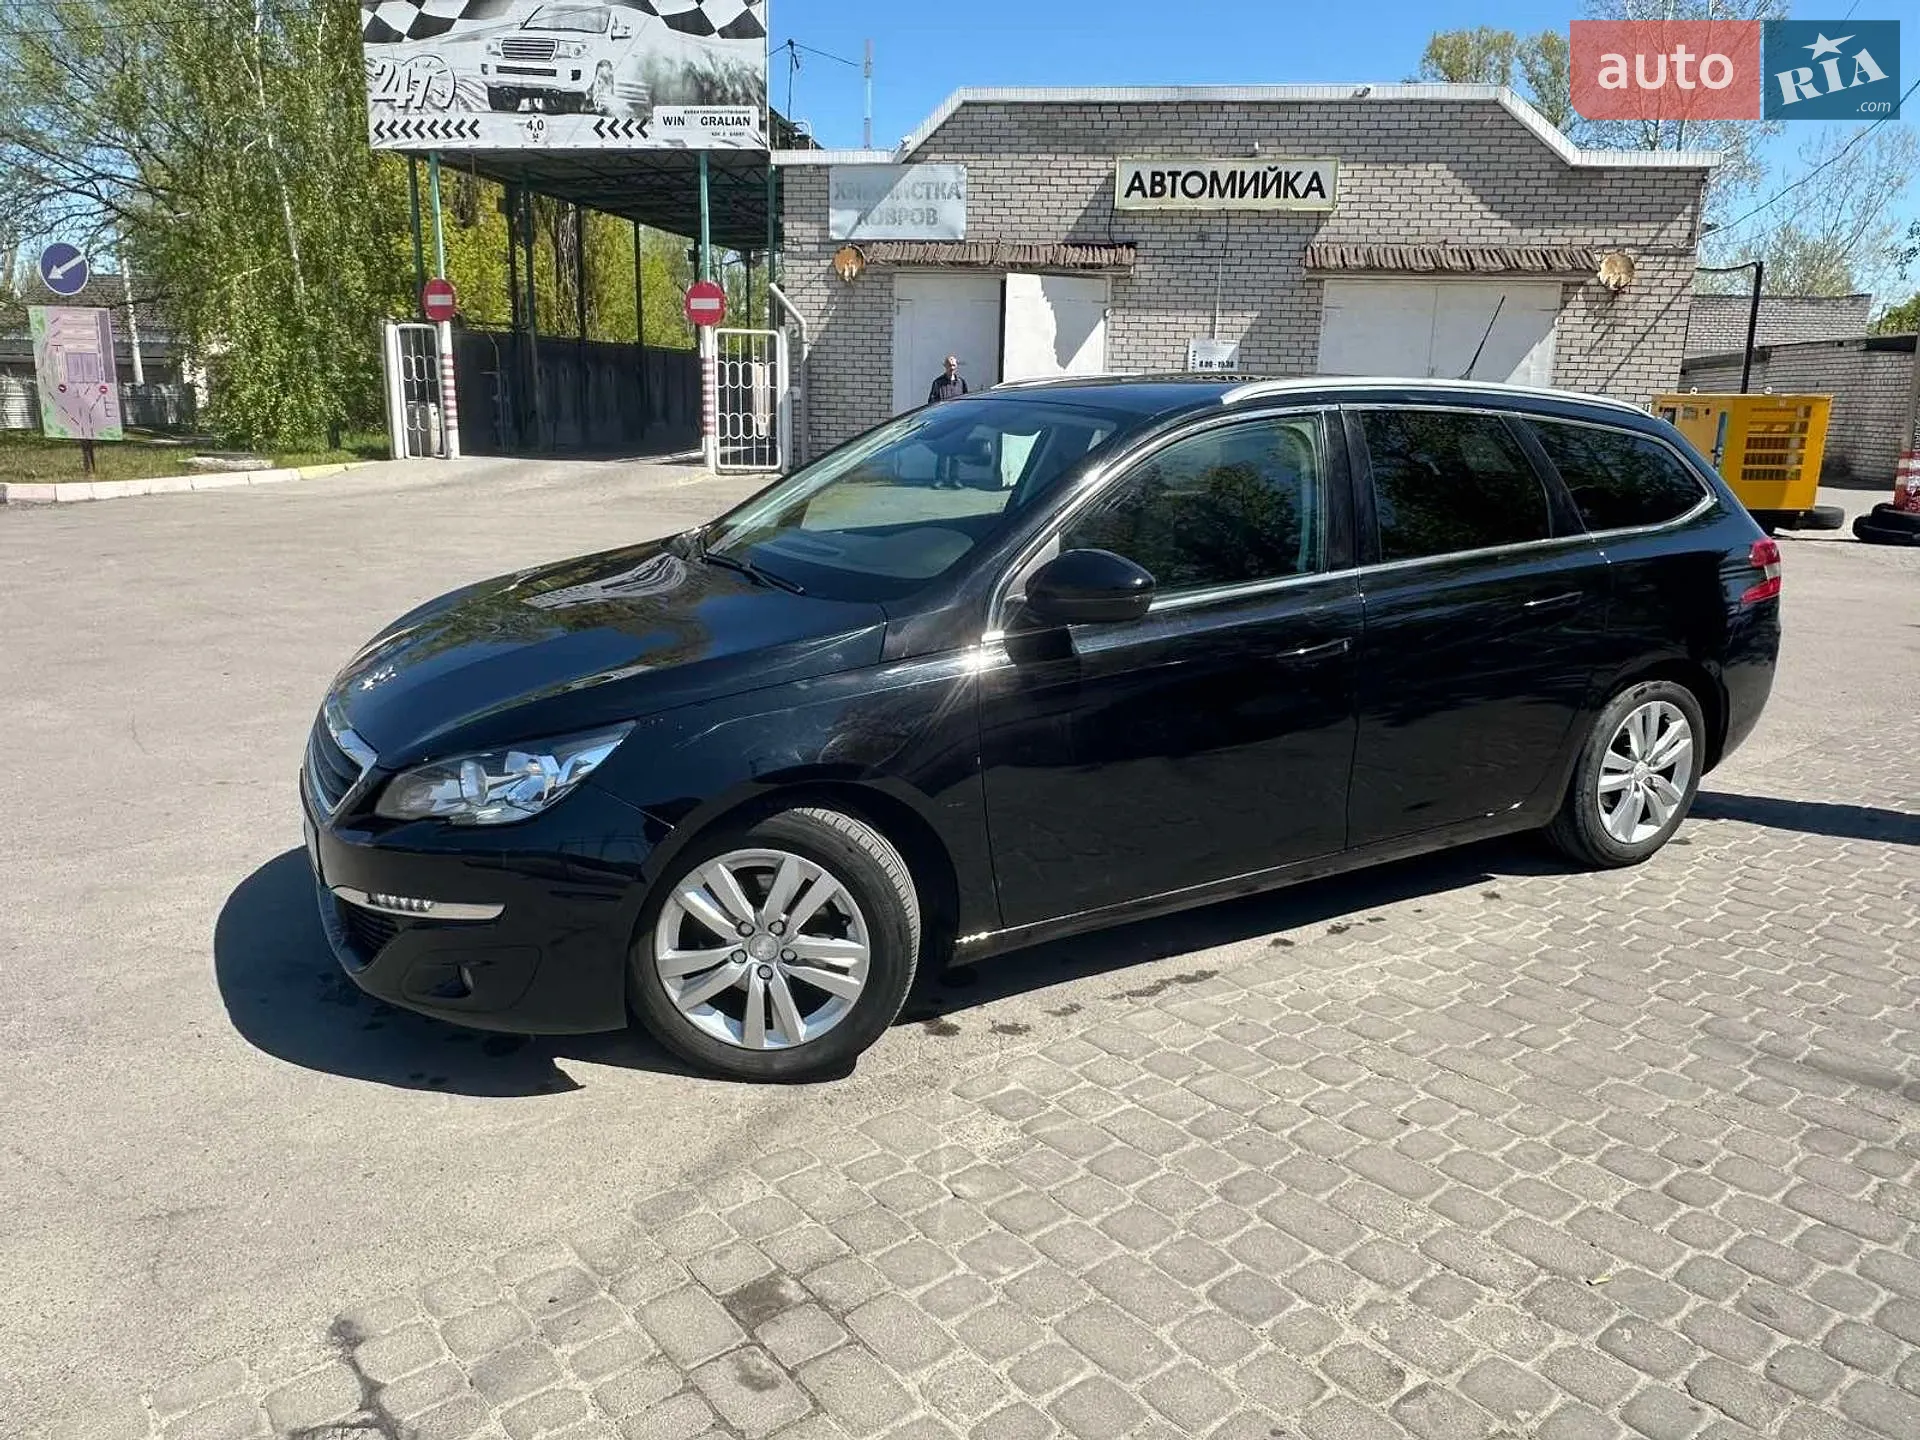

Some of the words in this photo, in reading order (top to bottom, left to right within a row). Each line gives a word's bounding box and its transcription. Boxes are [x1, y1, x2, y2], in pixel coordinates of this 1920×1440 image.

[662, 116, 685, 126] WIN
[700, 116, 750, 126] GRALIAN
[834, 181, 962, 201] ХИИСТКА
[1124, 166, 1326, 199] АВТОМИЙКА
